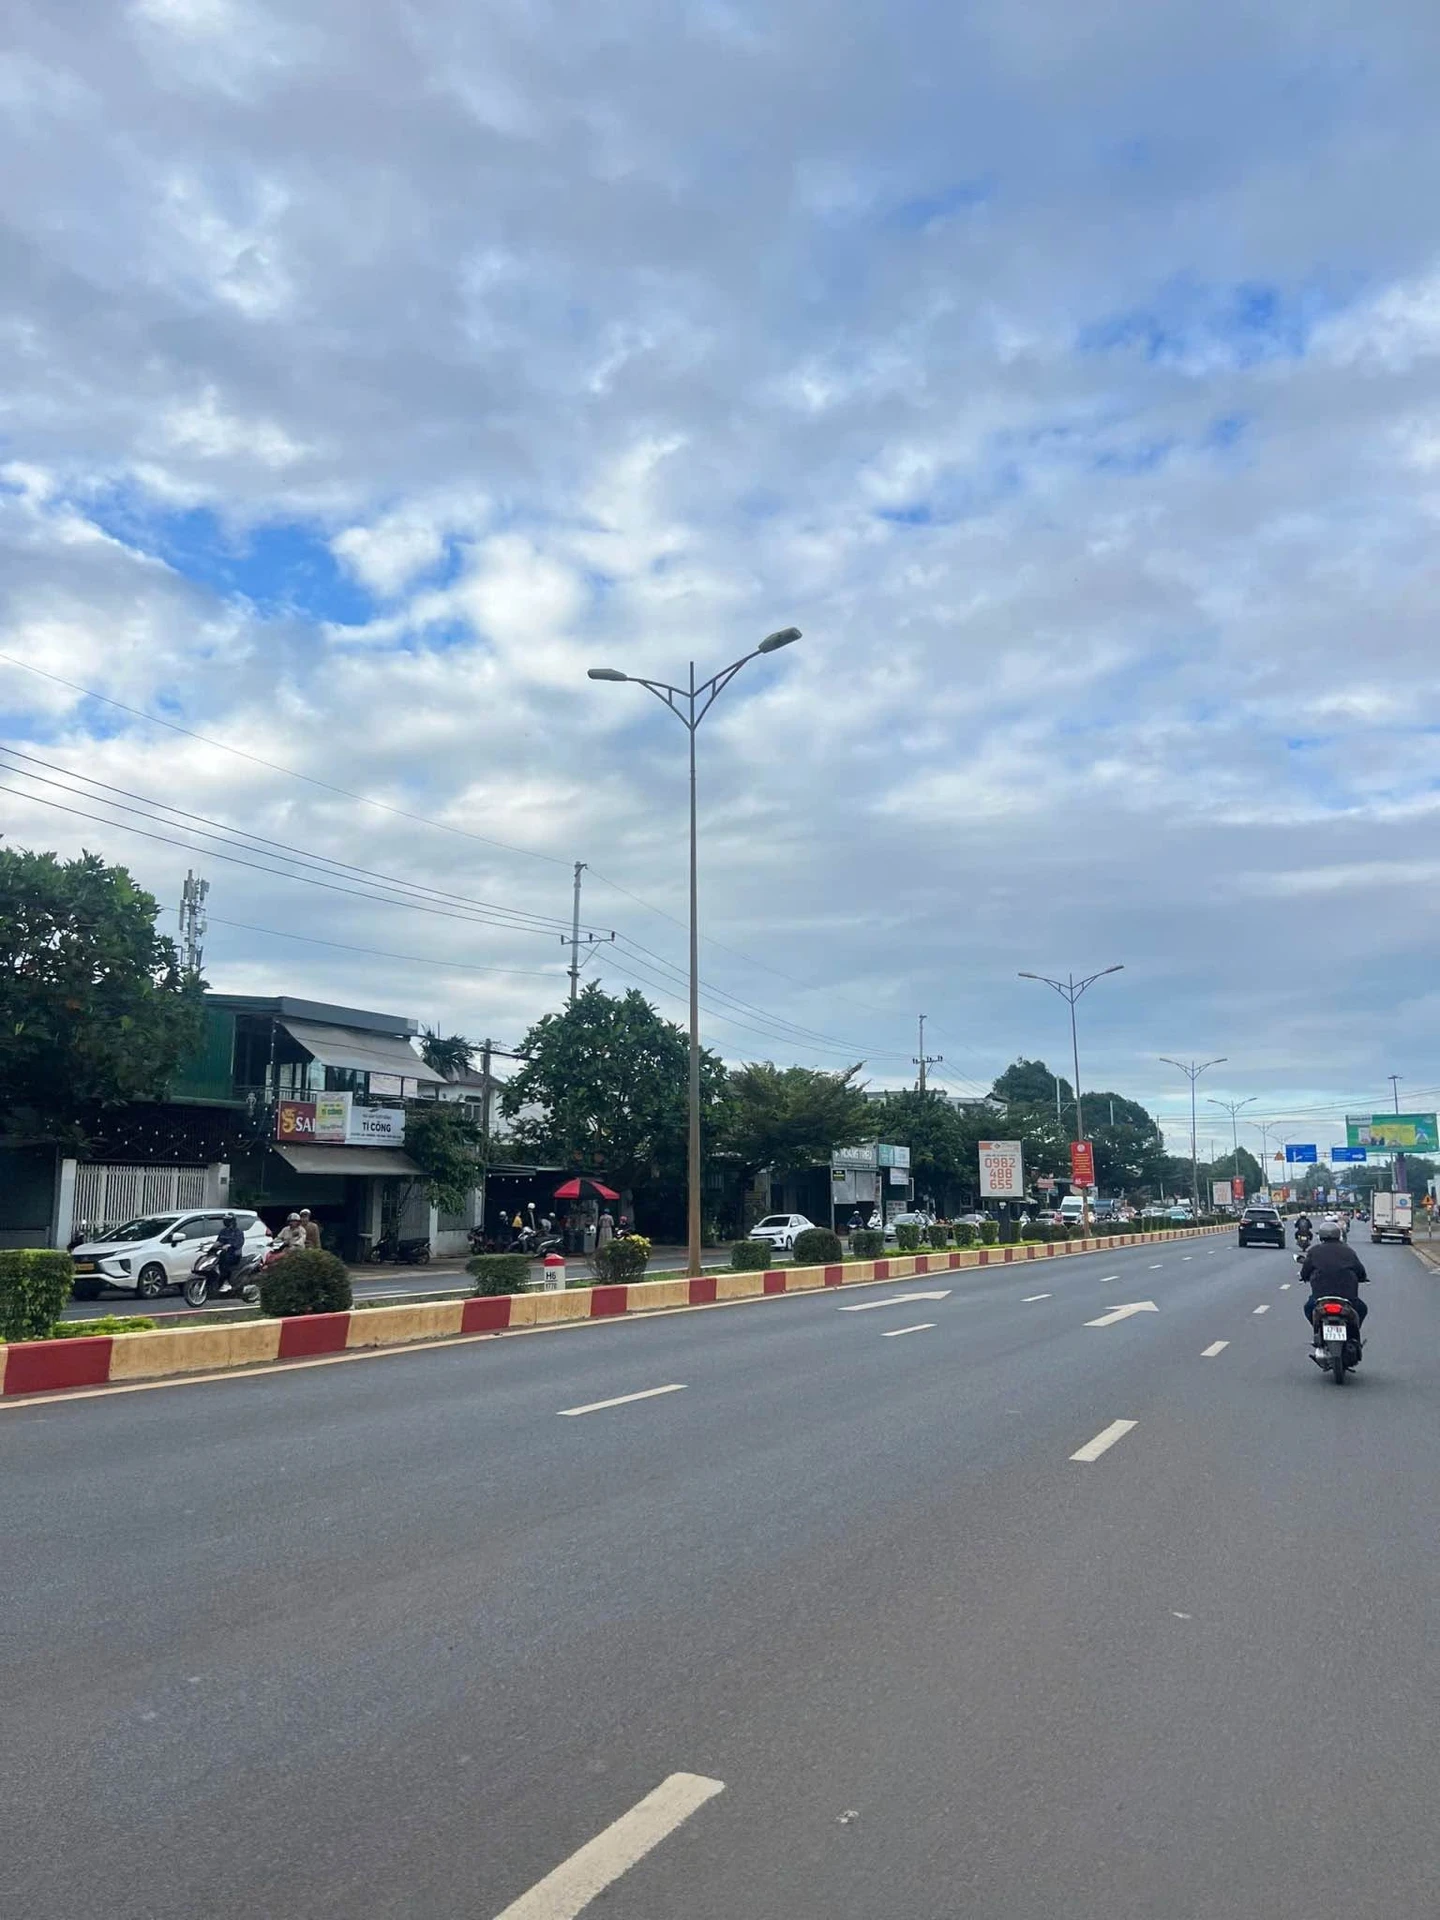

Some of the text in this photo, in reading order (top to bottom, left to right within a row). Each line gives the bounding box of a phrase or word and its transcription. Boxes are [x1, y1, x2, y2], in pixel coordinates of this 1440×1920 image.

[370, 1120, 391, 1133] CÔNG
[984, 1157, 1016, 1168] 0982
[990, 1168, 1012, 1179] 488
[990, 1179, 1012, 1190] 655
[545, 1271, 557, 1280] H6
